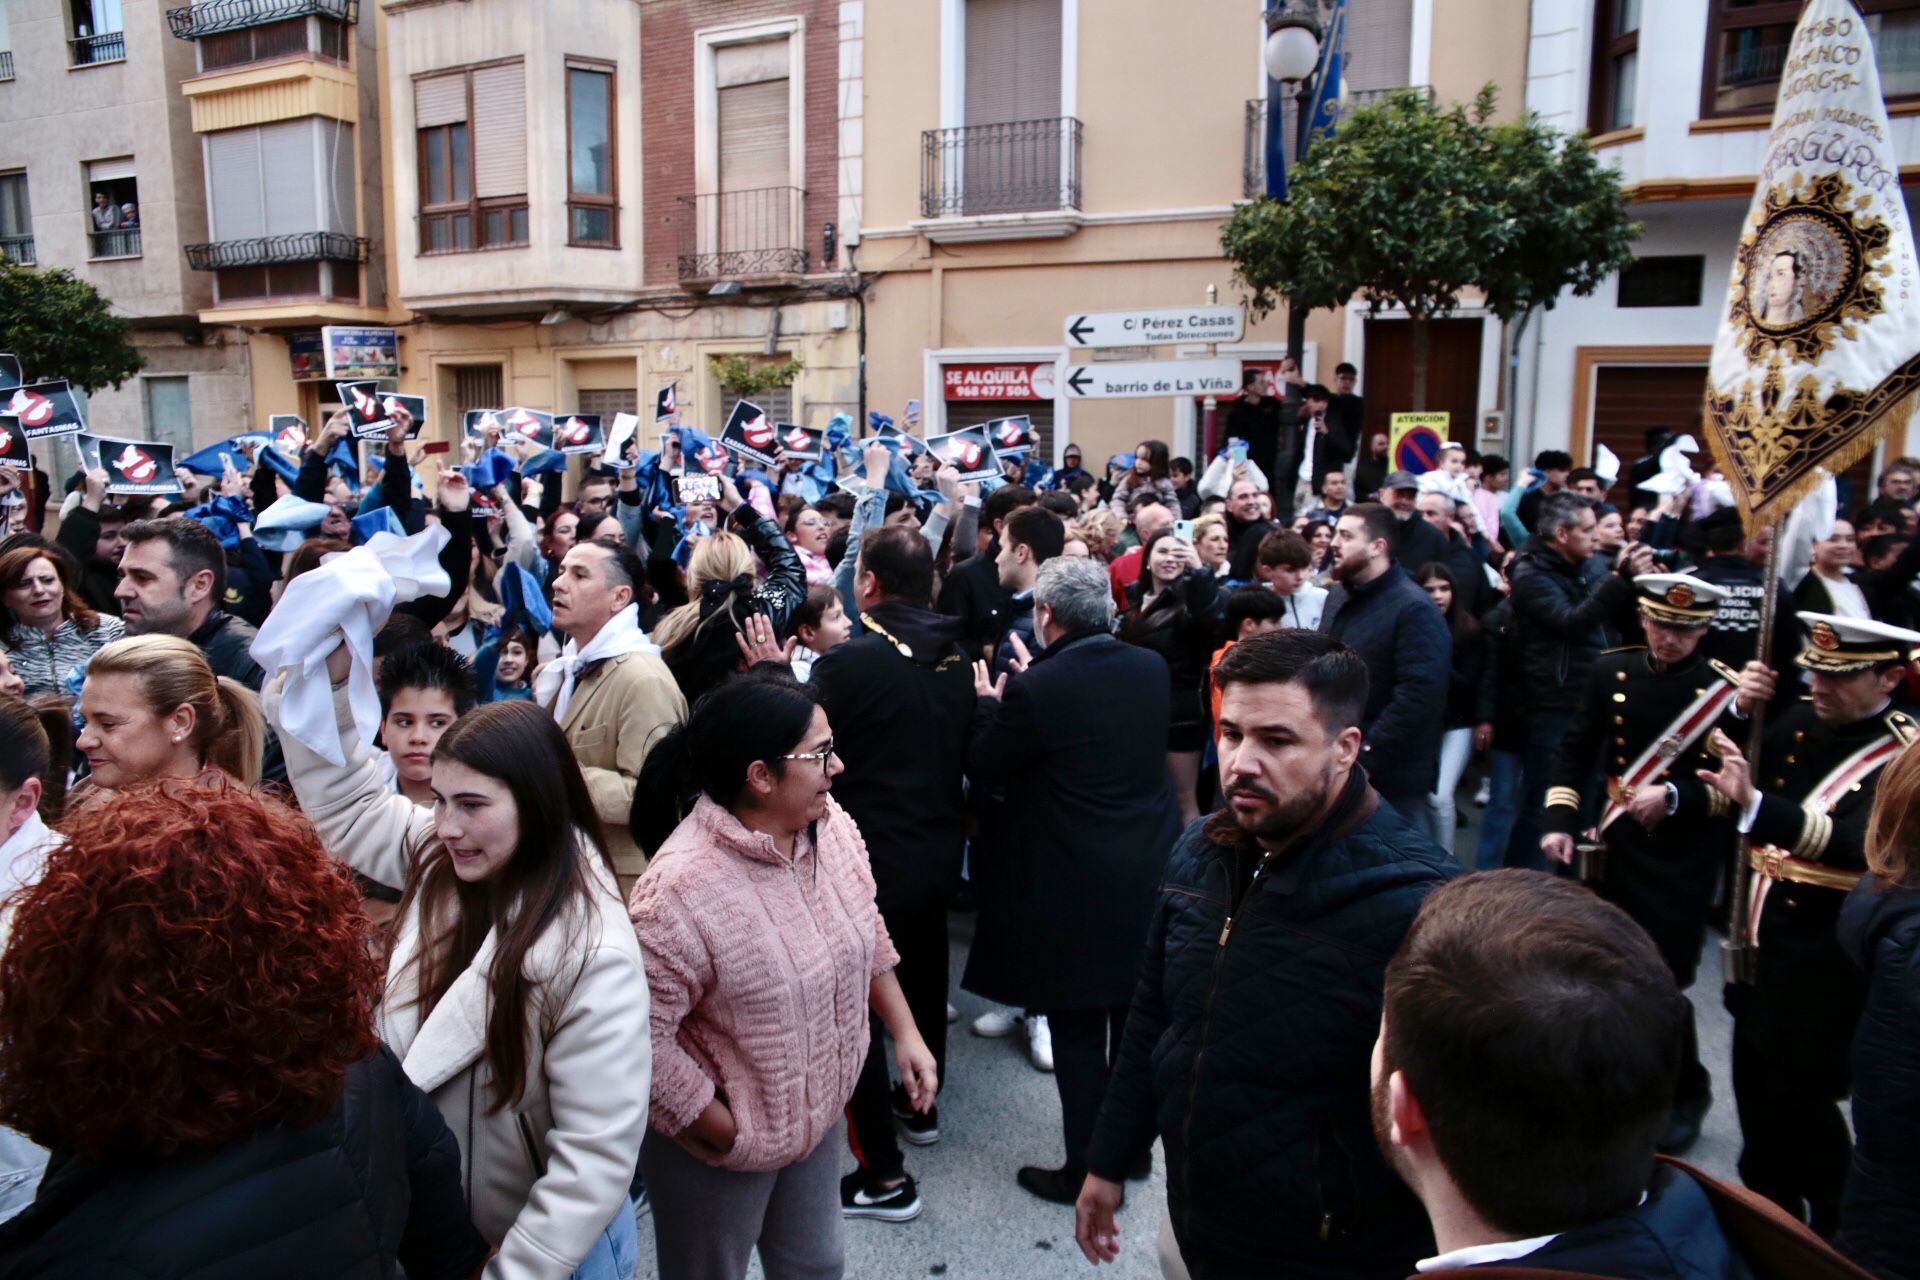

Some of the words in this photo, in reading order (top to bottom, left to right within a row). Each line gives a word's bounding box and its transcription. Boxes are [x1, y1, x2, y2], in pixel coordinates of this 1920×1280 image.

[1123, 318, 1138, 331] C/
[1142, 316, 1184, 330] Pérez
[1188, 315, 1235, 329] Casas
[1145, 332, 1173, 342] Todas
[1176, 330, 1235, 341] Direcciones
[945, 370, 963, 385] SE
[964, 369, 1029, 385] ALQUILA
[956, 385, 979, 397] 968
[980, 385, 1005, 397] 477
[1006, 385, 1031, 397] 506
[1105, 380, 1149, 394] barrio
[1153, 379, 1171, 392] de
[1176, 379, 1194, 391] La
[1199, 377, 1233, 391] Viña
[1720, 599, 1753, 608] LOCAL
